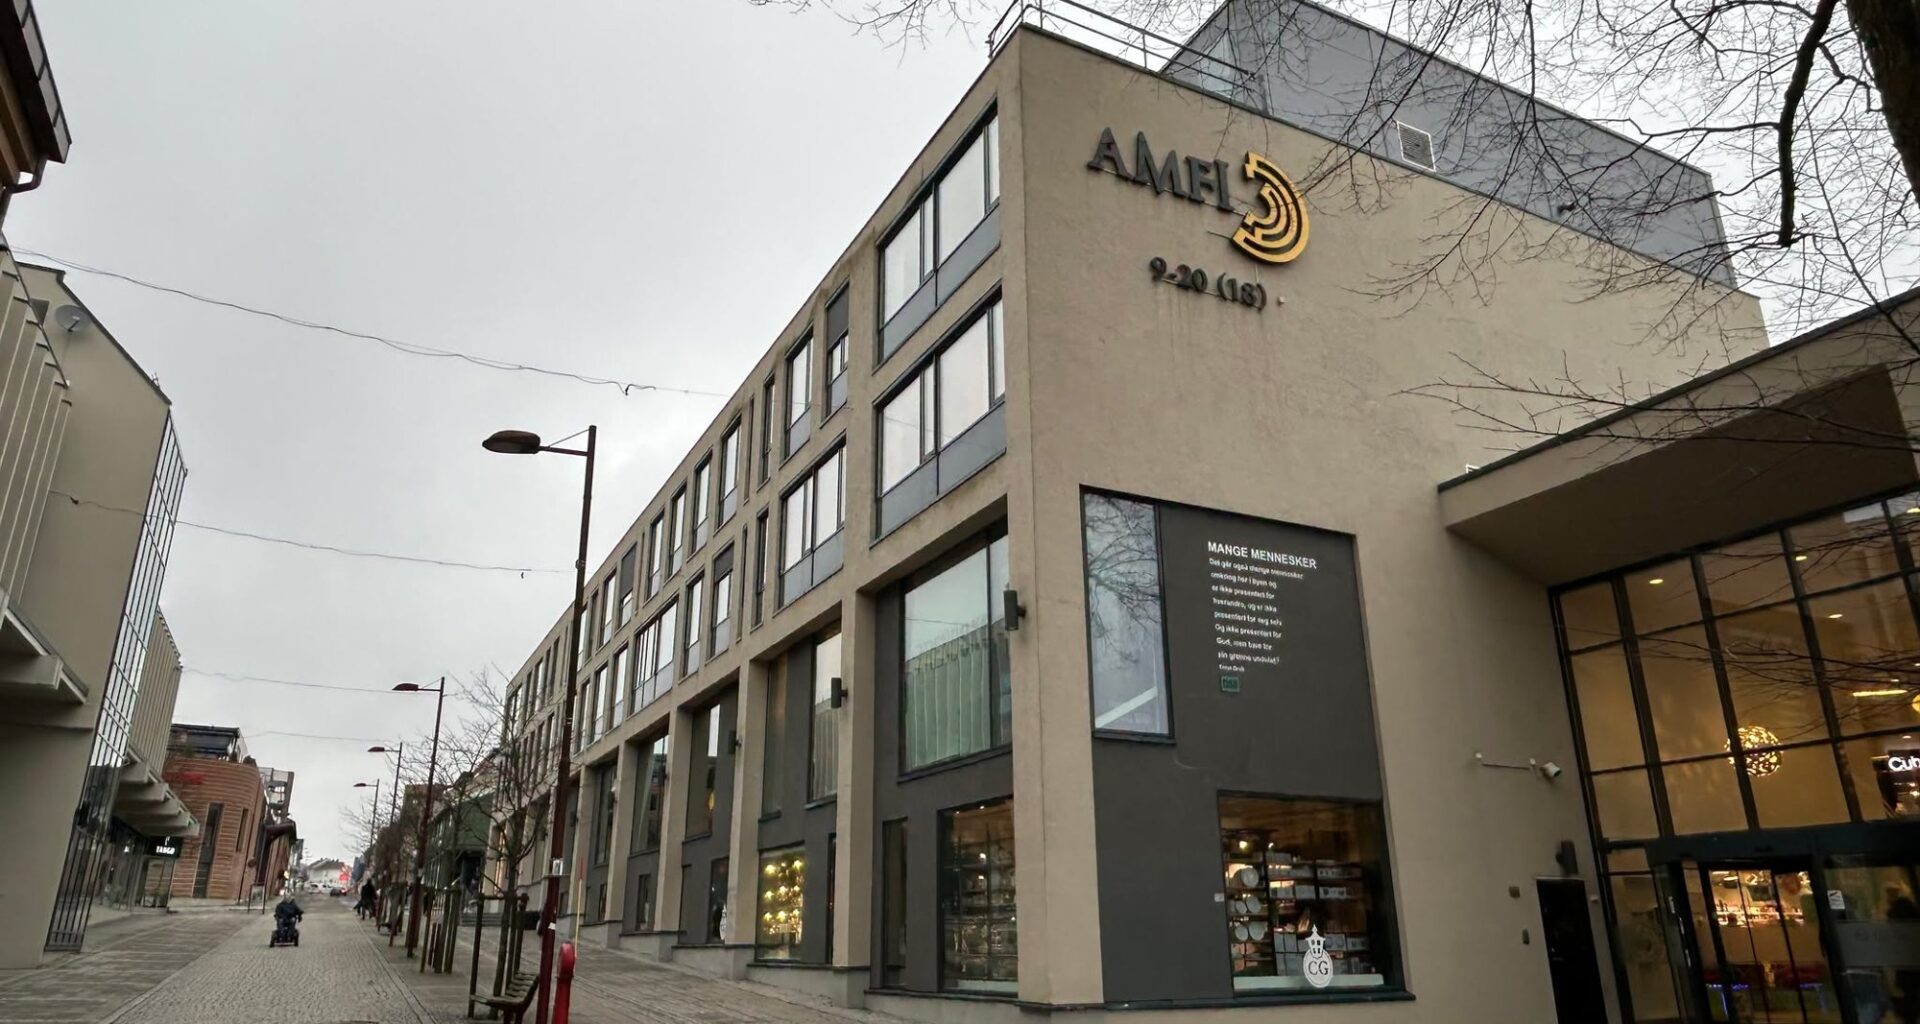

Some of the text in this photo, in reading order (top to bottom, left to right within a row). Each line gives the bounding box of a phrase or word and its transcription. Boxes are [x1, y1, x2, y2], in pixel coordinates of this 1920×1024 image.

[1087, 127, 1233, 212] AMFI
[1150, 256, 1267, 310] 9-20 (18)
[1207, 541, 1317, 569] MANGE MENNESKER
[1308, 960, 1328, 976] CG
